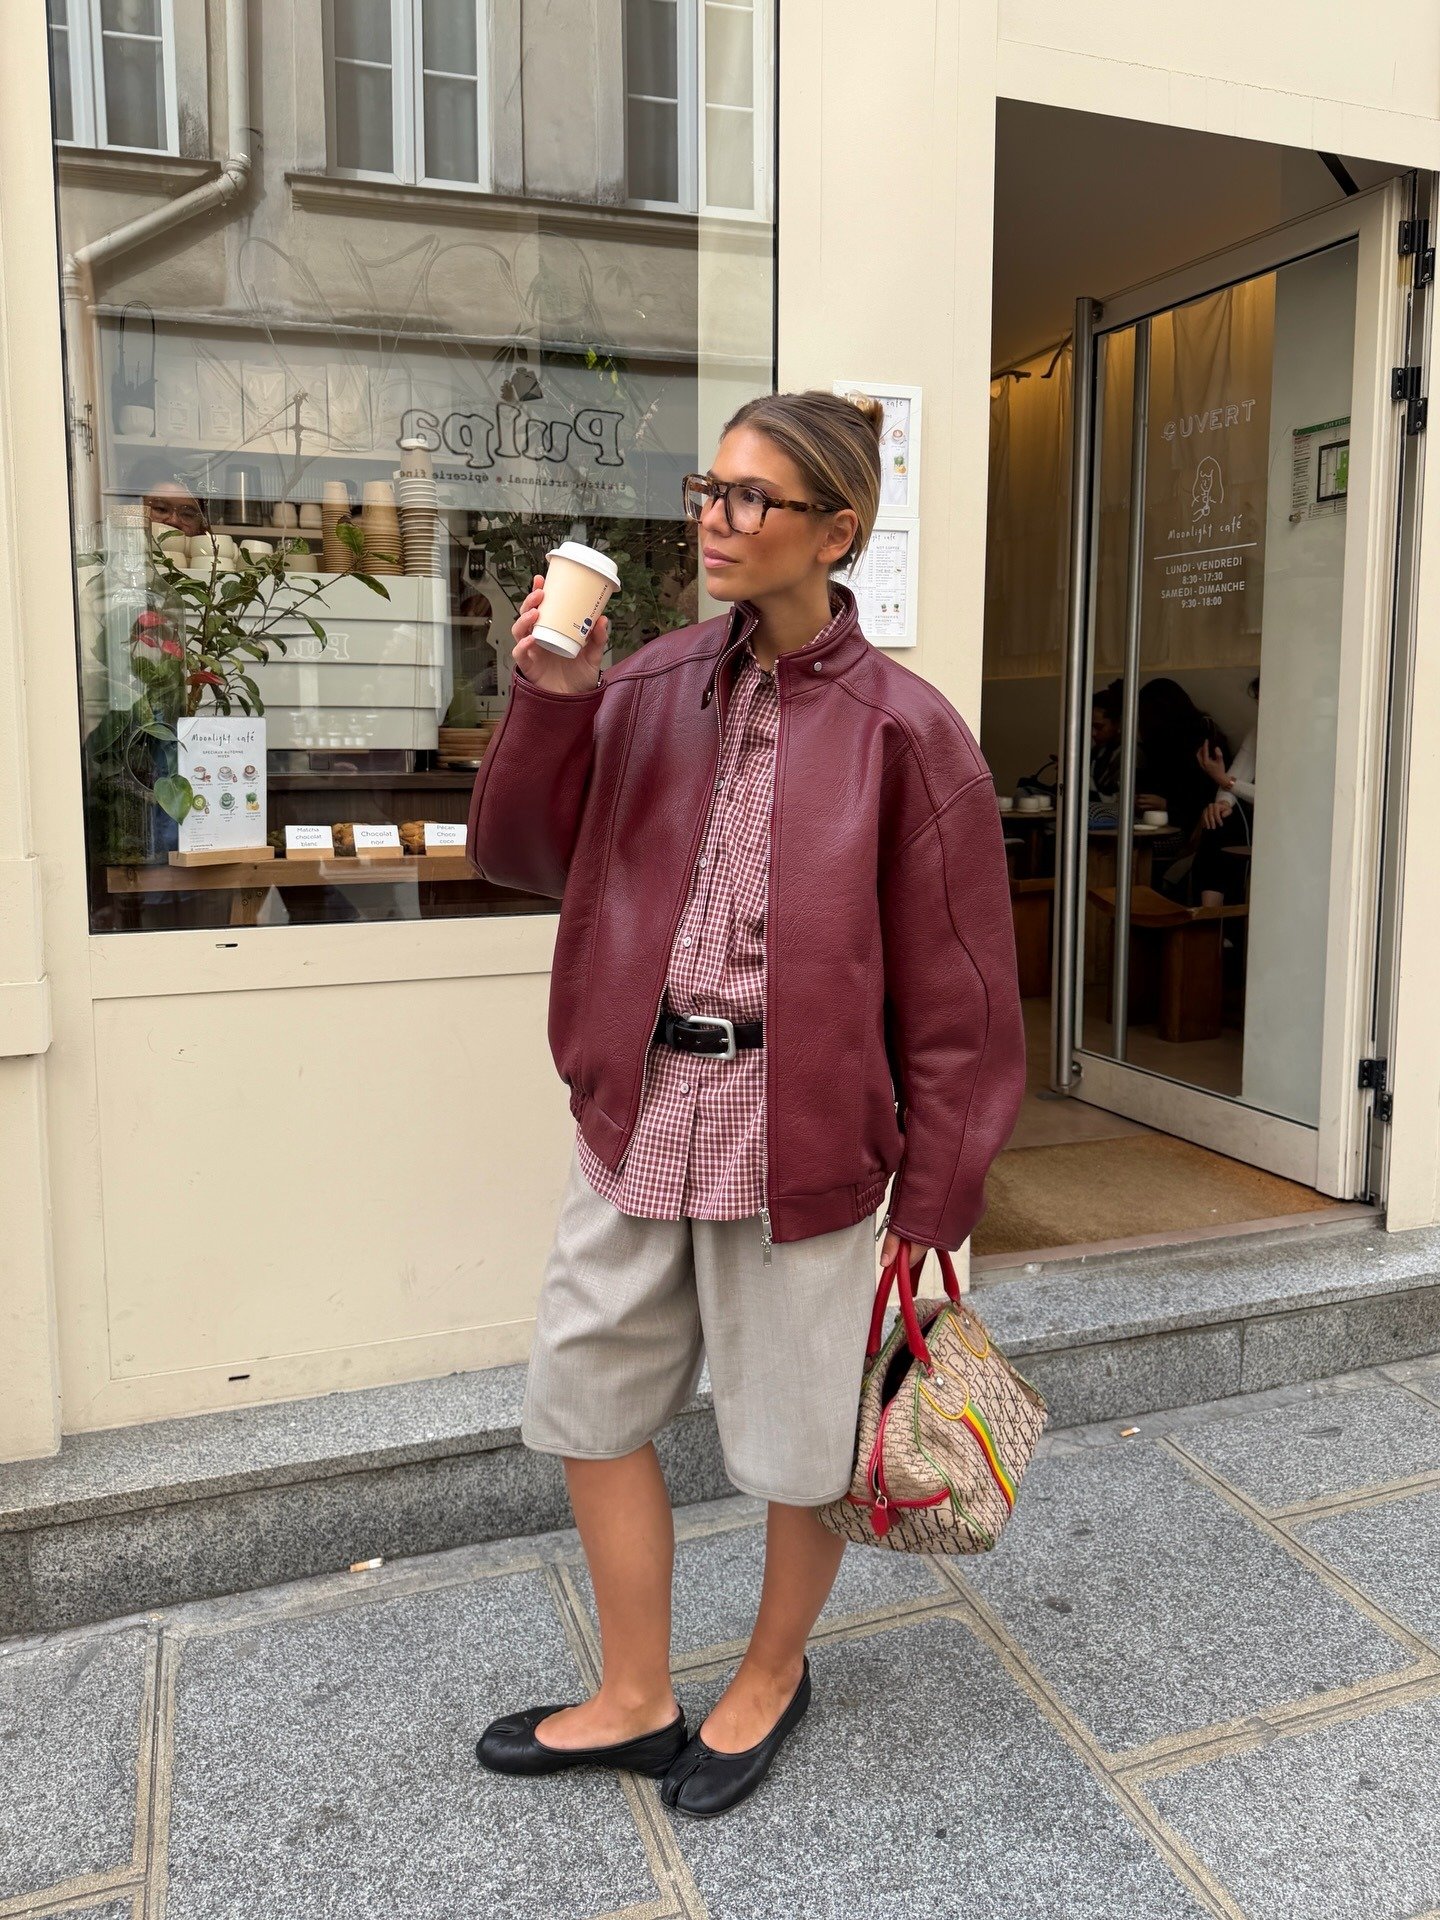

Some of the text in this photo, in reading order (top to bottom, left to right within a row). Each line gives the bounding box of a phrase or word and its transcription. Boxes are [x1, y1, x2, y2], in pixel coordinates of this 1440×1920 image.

[1167, 513, 1243, 545] Moonlight café
[1165, 563, 1191, 575] LUNDI
[1196, 556, 1243, 571] VENDREDI
[1182, 574, 1198, 585] 8:30
[1203, 571, 1223, 582] 17:30
[1161, 587, 1193, 599] SAMEDI
[1198, 580, 1245, 595] DIMANCHE
[1181, 598, 1197, 609] 9:30
[1202, 596, 1222, 606] 18:00
[191, 731, 255, 746] Moonlight café
[360, 830, 392, 838] Chocolat
